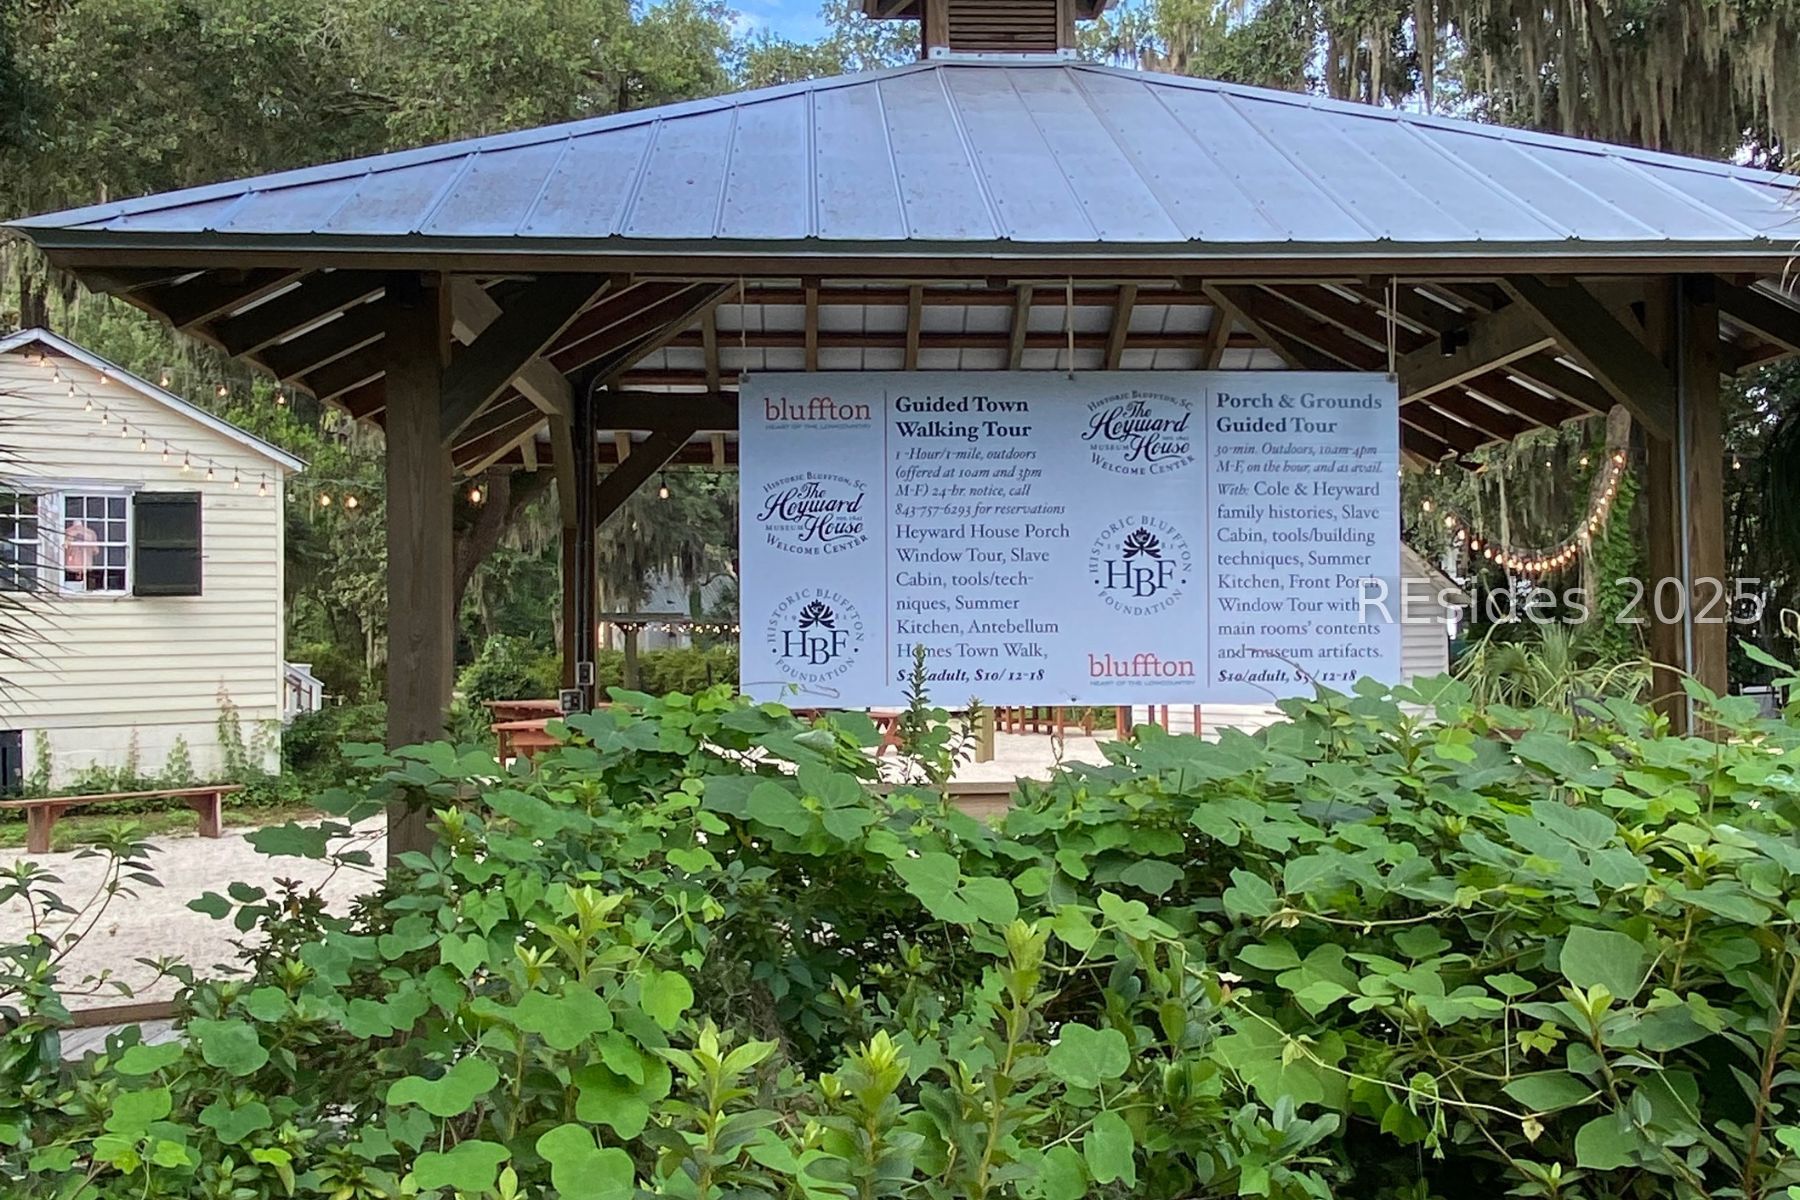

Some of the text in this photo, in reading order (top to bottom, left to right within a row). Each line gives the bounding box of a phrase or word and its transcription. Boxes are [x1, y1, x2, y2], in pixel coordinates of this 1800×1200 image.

[764, 397, 871, 420] bluffton
[895, 396, 1029, 413] Guided Town
[1122, 400, 1152, 418] The
[1216, 392, 1382, 410] Porch & Grounds
[895, 421, 1032, 442] Walking Tour
[1081, 406, 1191, 442] Heyward
[1216, 417, 1338, 433] Guided Tour
[986, 449, 1036, 460] outdoors
[1124, 433, 1190, 462] House
[1261, 442, 1316, 455] Outdoors,
[1319, 446, 1377, 458] 10am-4pm
[1091, 452, 1196, 475] WELCOME CENTER
[1247, 464, 1260, 472] on
[1263, 461, 1280, 472] the
[1283, 460, 1310, 474] hour,
[1313, 461, 1335, 473] and
[1337, 464, 1348, 472] as
[1351, 461, 1383, 473] avail.
[895, 465, 1042, 482] (offered at 10am and 3pm
[763, 474, 803, 493] HISTORIC
[853, 479, 868, 491] SC
[797, 482, 826, 499] The
[895, 484, 928, 497] M-F)
[969, 486, 1006, 498] notice,
[1009, 484, 1031, 496] call
[1254, 481, 1290, 496] Cole
[1294, 484, 1308, 496] &
[1313, 481, 1380, 500] Heyward
[757, 487, 865, 523] Heyward
[895, 502, 1065, 518] 843-757-6293 for reservations
[1217, 504, 1380, 523] family histories, Slave
[798, 513, 864, 541] House
[896, 523, 1070, 543] Heyward House Porch
[1217, 526, 1375, 546] Cabin, tools/building
[767, 533, 868, 555] WELCOME CENTER
[1089, 515, 1192, 573] HISTORIC BLUFFTON
[896, 547, 1050, 565] Window Tour, Slave
[1217, 550, 1371, 569] techniques, Summer
[896, 571, 1034, 588] Cabin, tools/tech-
[1104, 560, 1177, 597] HBF
[1218, 574, 1284, 590] Kitchen,
[1288, 574, 1330, 588] Front
[896, 595, 1020, 614] niques, Summer
[1098, 588, 1183, 616] FOUNDATION
[1218, 597, 1360, 612] Window Tour with
[767, 588, 865, 642] HISTORIC BLUFFTON
[896, 618, 1059, 635] Kitchen, Antebellum
[1218, 621, 1256, 635] main
[1315, 622, 1381, 635] contents
[781, 630, 850, 665] HBF
[896, 642, 1048, 659] Homes Town Walk,
[1218, 643, 1383, 658] and museum artifacts.
[775, 657, 855, 682] FOUNDATION
[1087, 653, 1195, 677] bluffton
